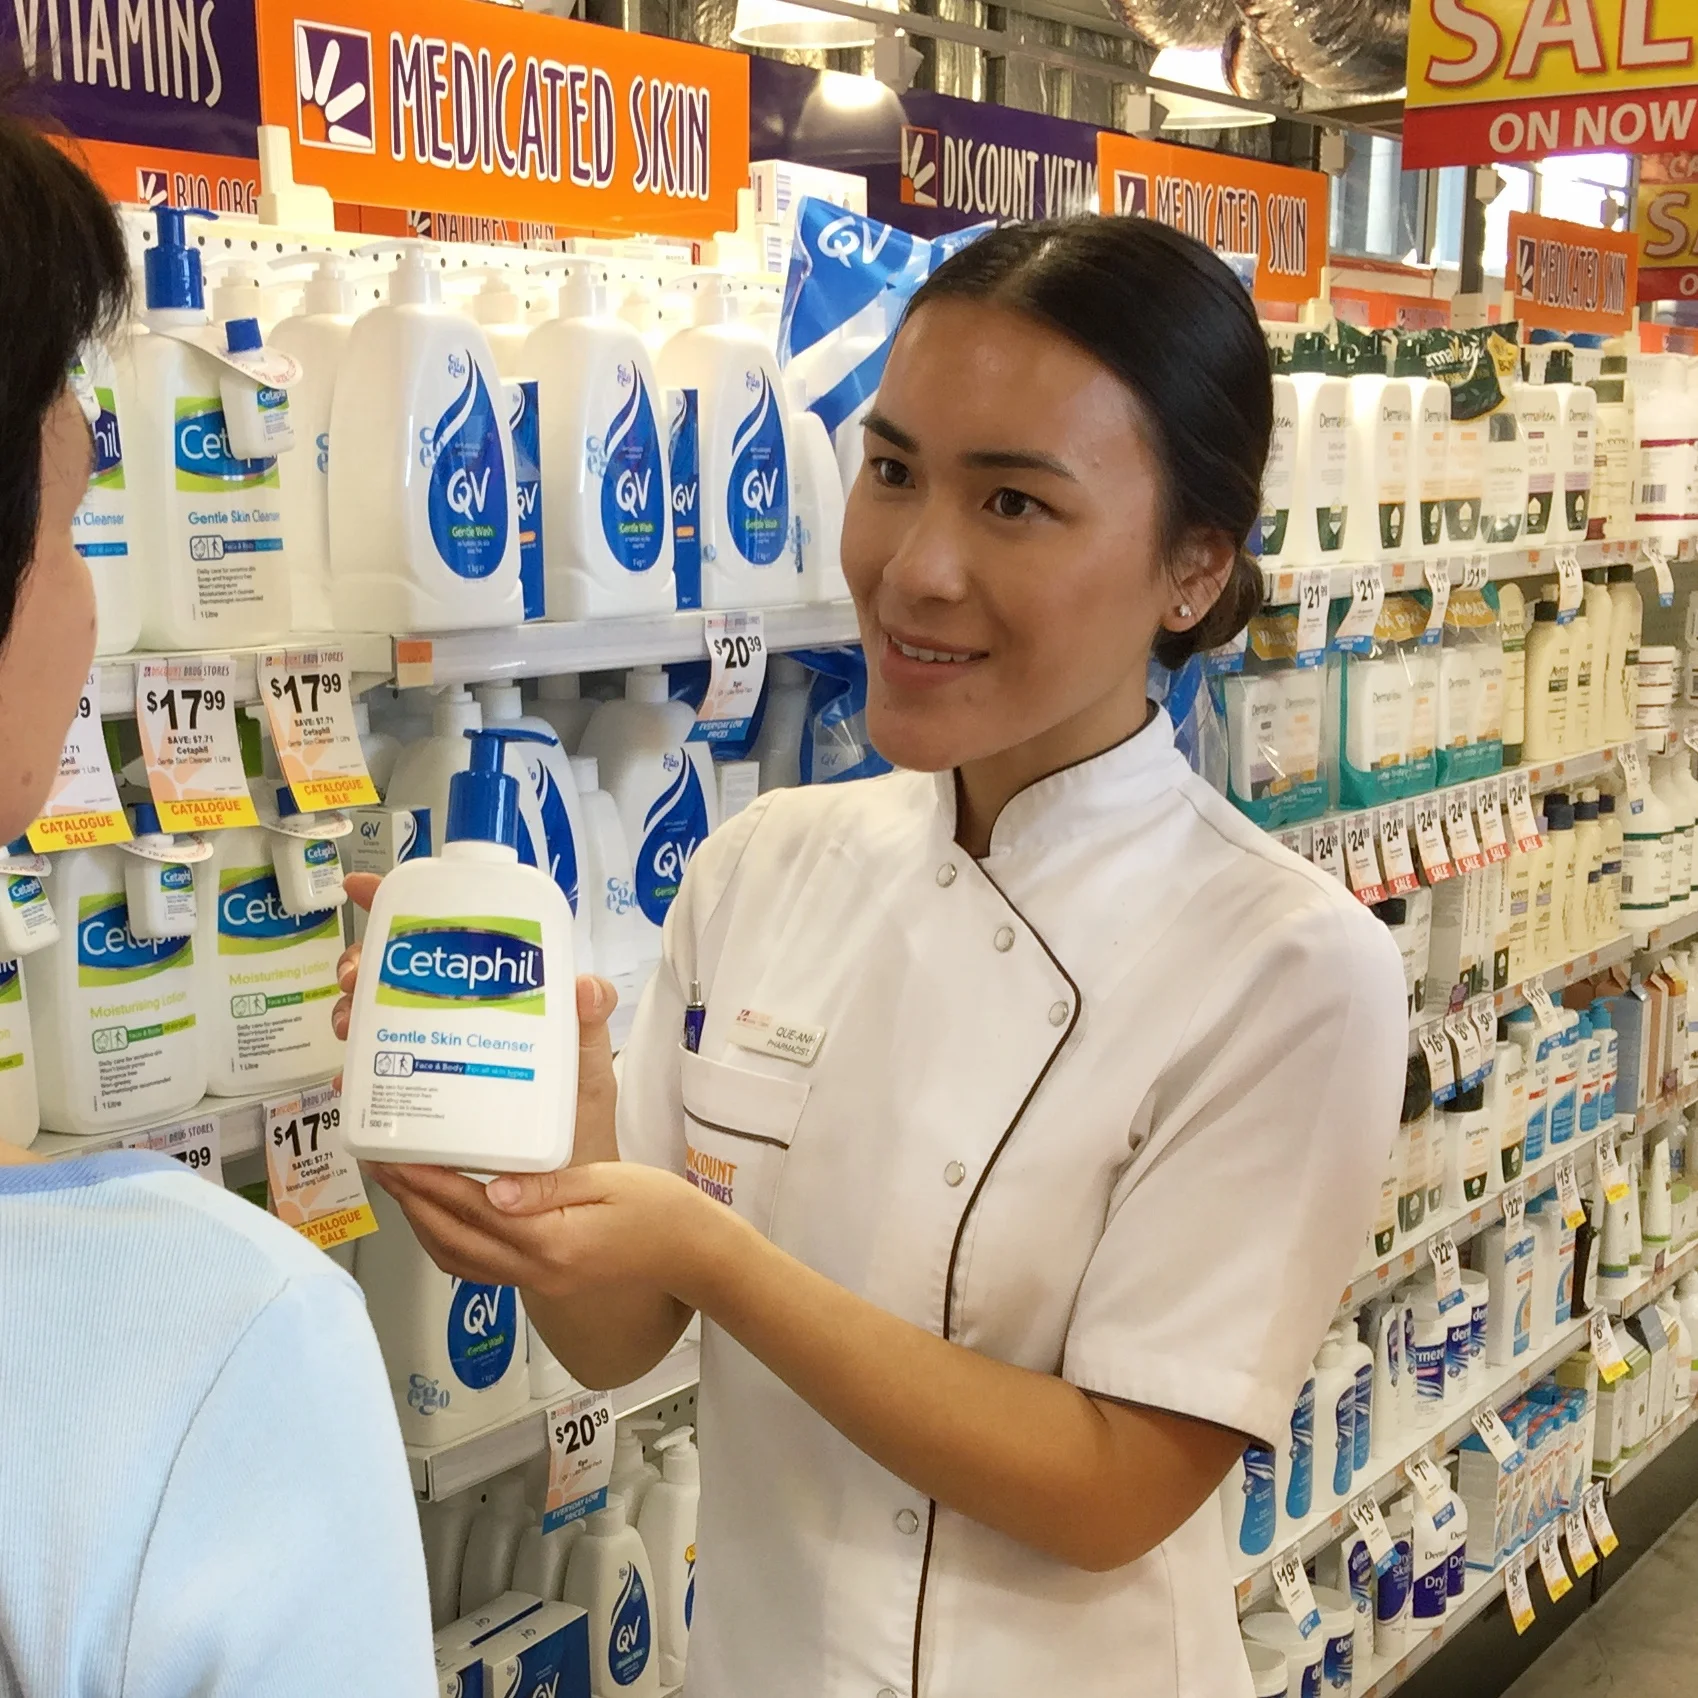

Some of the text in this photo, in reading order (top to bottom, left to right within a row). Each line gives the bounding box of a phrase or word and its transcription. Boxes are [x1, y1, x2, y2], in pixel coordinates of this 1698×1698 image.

[13, 0, 223, 108] VITAMINS
[389, 30, 711, 202] MEDICATED SKIN
[1489, 99, 1698, 154] ON NOW
[943, 135, 1039, 221] DISCOUNT
[817, 215, 893, 269] QV
[1266, 192, 1308, 277] SKIN
[1537, 238, 1600, 314] MEDICATED
[446, 467, 491, 522] QV
[616, 468, 651, 519] QV
[673, 482, 697, 517] QV
[742, 466, 788, 516] QV
[188, 510, 228, 525] Gentle
[231, 509, 251, 523] Skin
[183, 666, 202, 678] DRUG
[203, 665, 230, 677] STORES
[303, 779, 364, 795] CATALOGUE
[324, 792, 351, 806] SALE
[171, 800, 242, 816] CATALOGUE
[193, 814, 225, 828] SALE
[39, 815, 115, 835] CATALOGUE
[64, 831, 98, 845] SALE
[360, 821, 381, 840] QV
[1361, 886, 1381, 905] SALE
[1394, 876, 1412, 894] SALE
[386, 941, 538, 990] Cetaphil
[376, 1028, 534, 1054] Gentle Skin Cleanser
[766, 1039, 811, 1057] PHARMACIST
[414, 1061, 433, 1070] Face
[434, 1062, 441, 1071] &
[442, 1063, 464, 1073] Body
[188, 1122, 215, 1137] STORES
[300, 1209, 363, 1240] CATALOGUE
[319, 1227, 348, 1246] SALE
[463, 1285, 502, 1337] QV
[616, 1615, 641, 1654] QV
